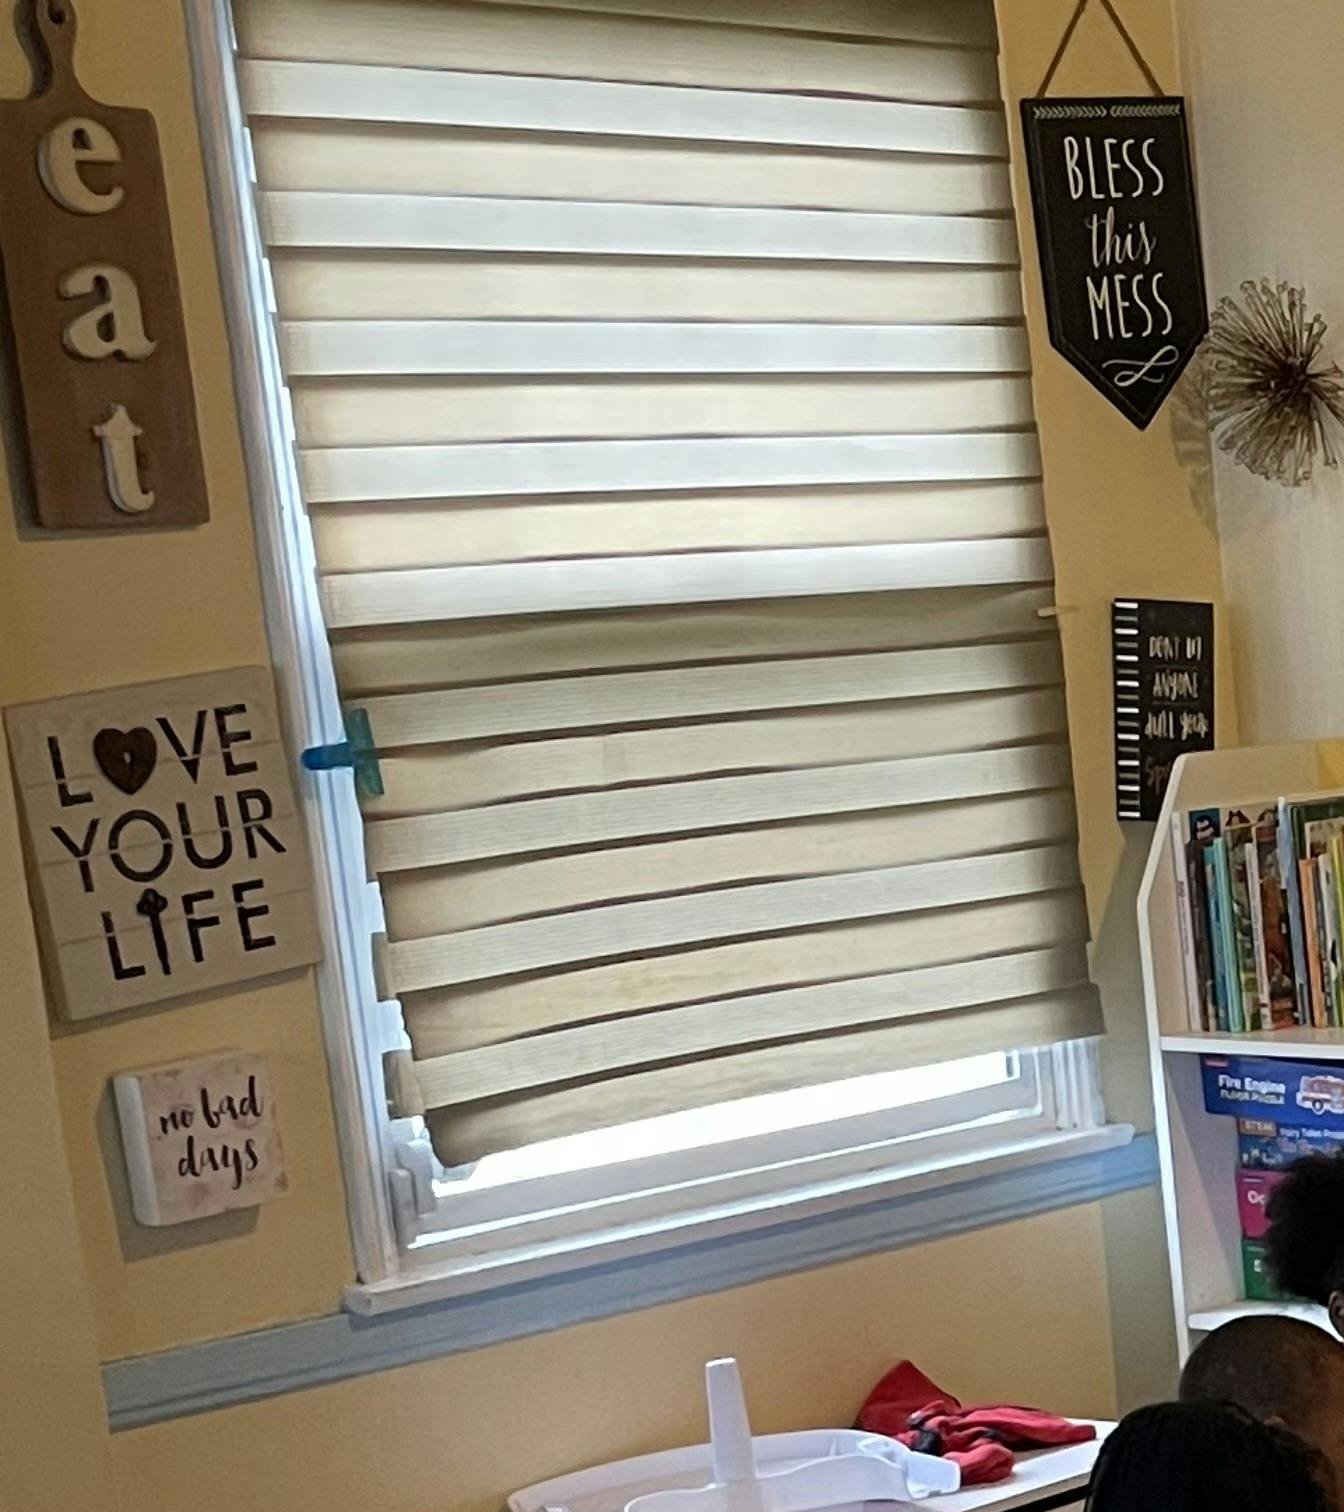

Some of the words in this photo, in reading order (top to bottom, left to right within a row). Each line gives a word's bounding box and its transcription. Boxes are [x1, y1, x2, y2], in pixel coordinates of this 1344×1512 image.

[1064, 136, 1165, 200] BLESS
[1085, 206, 1156, 268] this
[37, 116, 157, 516] eat
[1086, 272, 1173, 341] MESS
[52, 787, 287, 893] YOUR
[157, 1102, 195, 1136] no
[200, 1074, 264, 1124] bad
[1218, 1074, 1241, 1089] Fire
[1244, 1077, 1287, 1095] Engine
[178, 1136, 260, 1190] days
